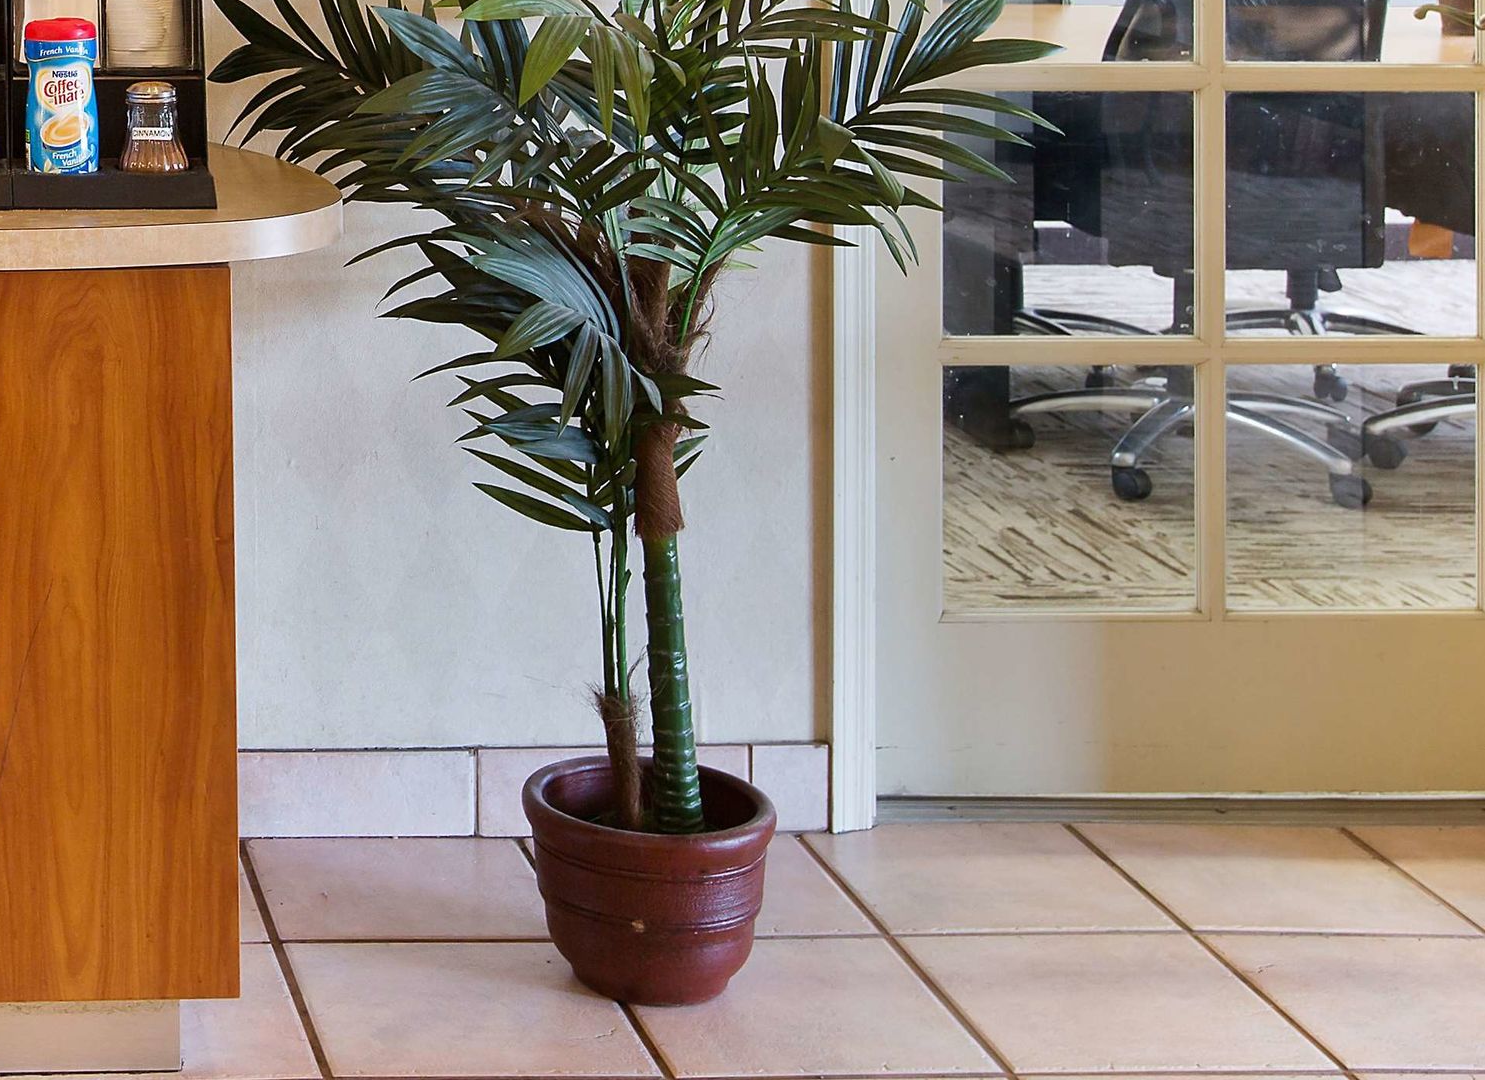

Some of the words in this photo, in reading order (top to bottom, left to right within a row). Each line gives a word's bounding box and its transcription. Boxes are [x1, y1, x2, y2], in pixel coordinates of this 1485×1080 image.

[40, 46, 63, 56] French
[133, 129, 171, 138] CINNAMON
[52, 149, 77, 160] French
